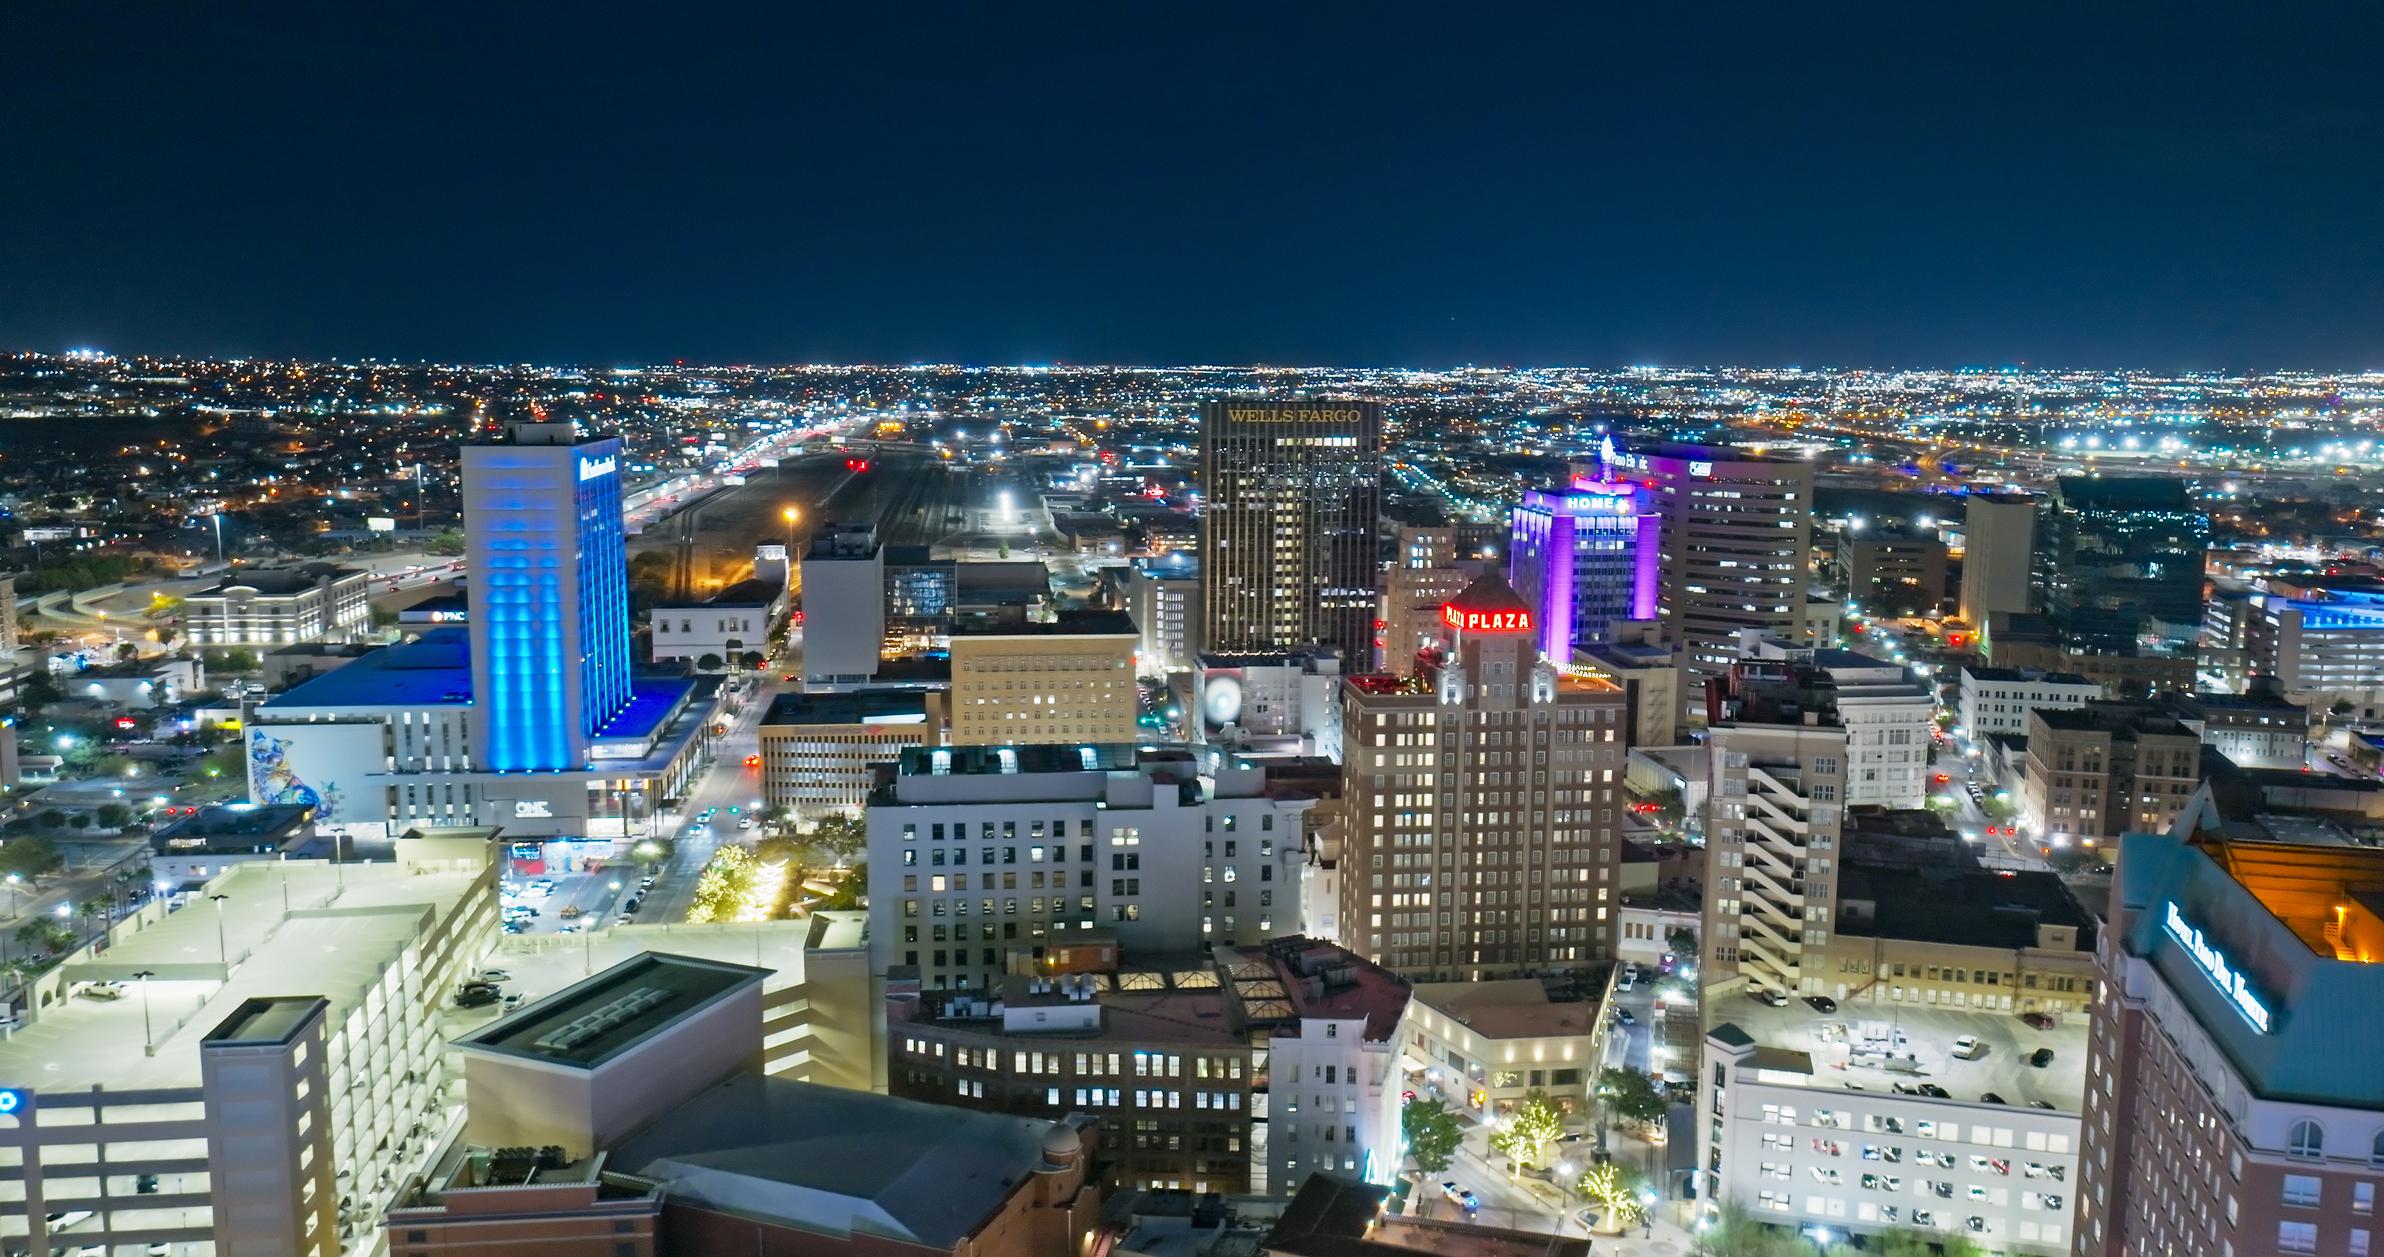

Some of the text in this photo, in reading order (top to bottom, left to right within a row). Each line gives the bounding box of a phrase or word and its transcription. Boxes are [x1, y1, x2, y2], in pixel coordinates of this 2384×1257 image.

[1228, 409, 1361, 422] WELLS FARGO
[1568, 497, 1614, 509] HOME
[443, 611, 465, 621] PNC
[1446, 606, 1464, 628] PLAZA
[1469, 613, 1529, 629] PLAZA
[515, 801, 549, 814] ONE
